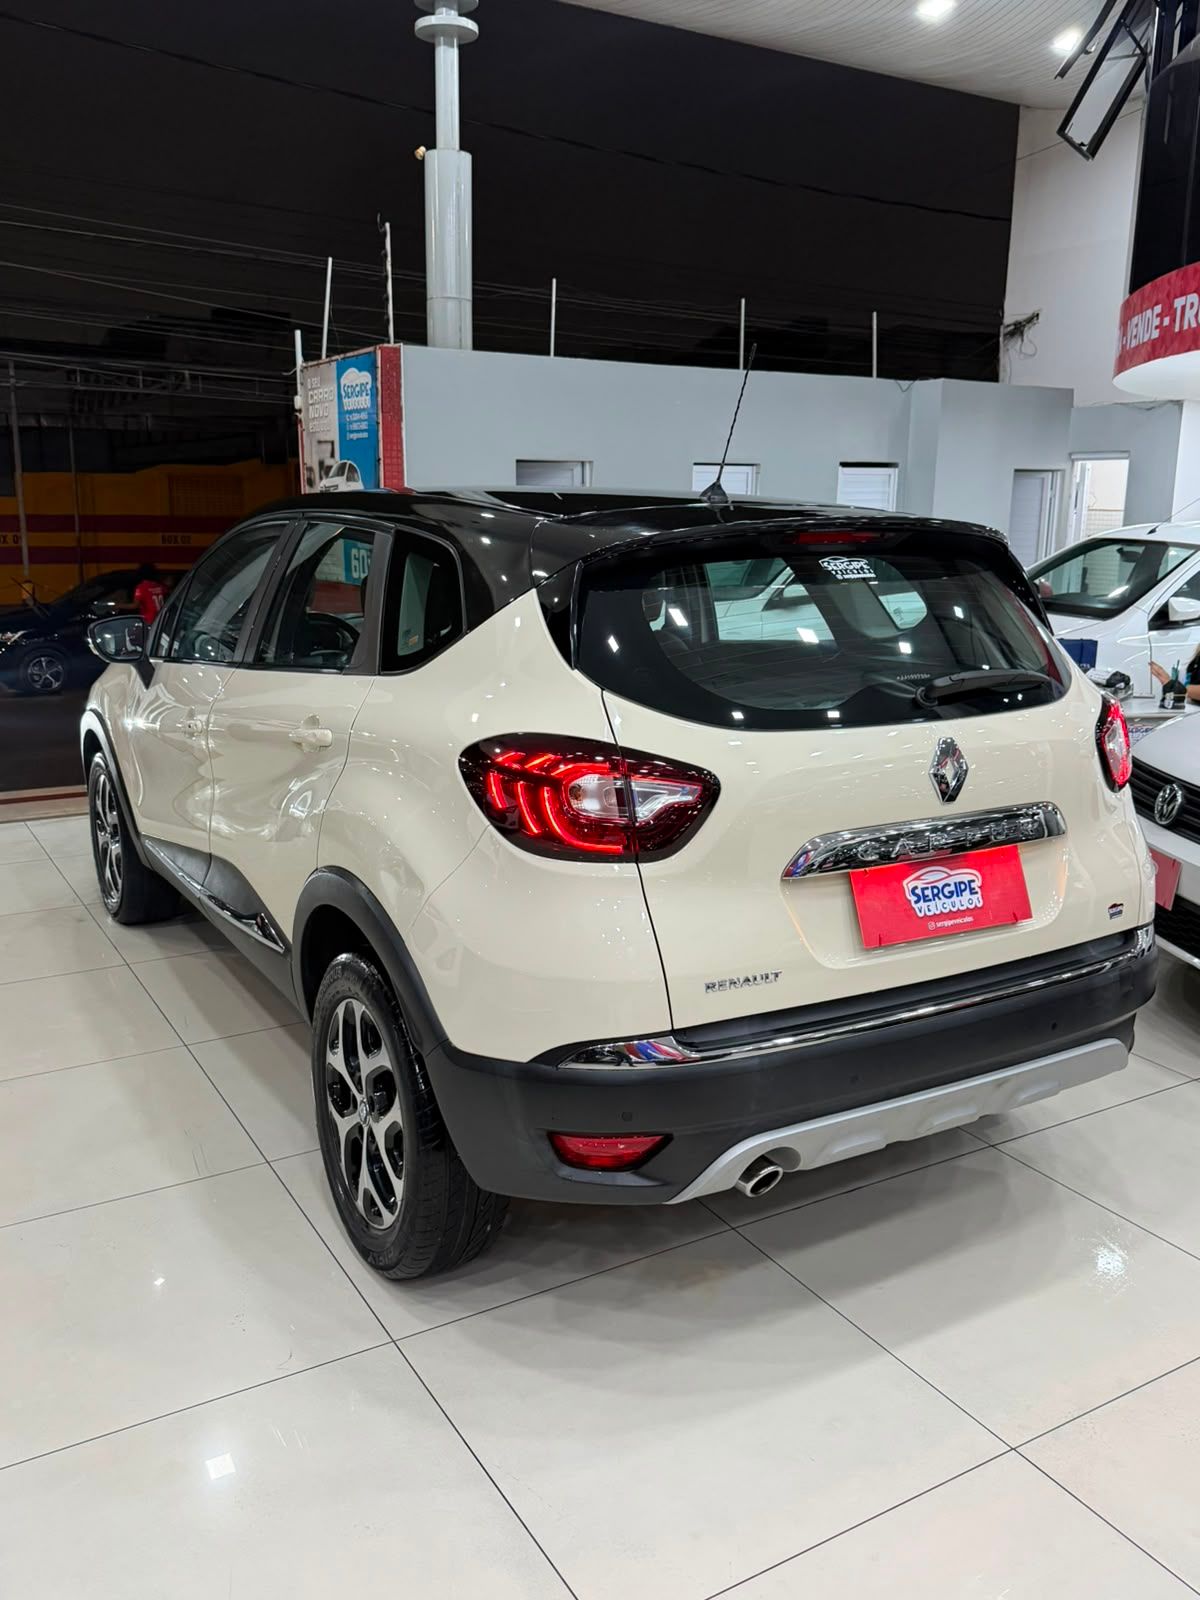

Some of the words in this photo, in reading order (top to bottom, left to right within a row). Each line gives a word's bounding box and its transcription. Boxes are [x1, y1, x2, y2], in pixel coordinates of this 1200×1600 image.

[1126, 304, 1162, 350] VENDE
[1173, 293, 1200, 332] TR
[308, 387, 334, 404] CARRO
[342, 382, 369, 399] SERGIPE
[308, 403, 329, 418] NOVO
[161, 535, 179, 545] BOX
[822, 561, 871, 571] SERGIPE
[910, 879, 979, 905] SERGIPE
[917, 897, 981, 914] VEÍCULOS
[704, 969, 783, 994] RENAULT
